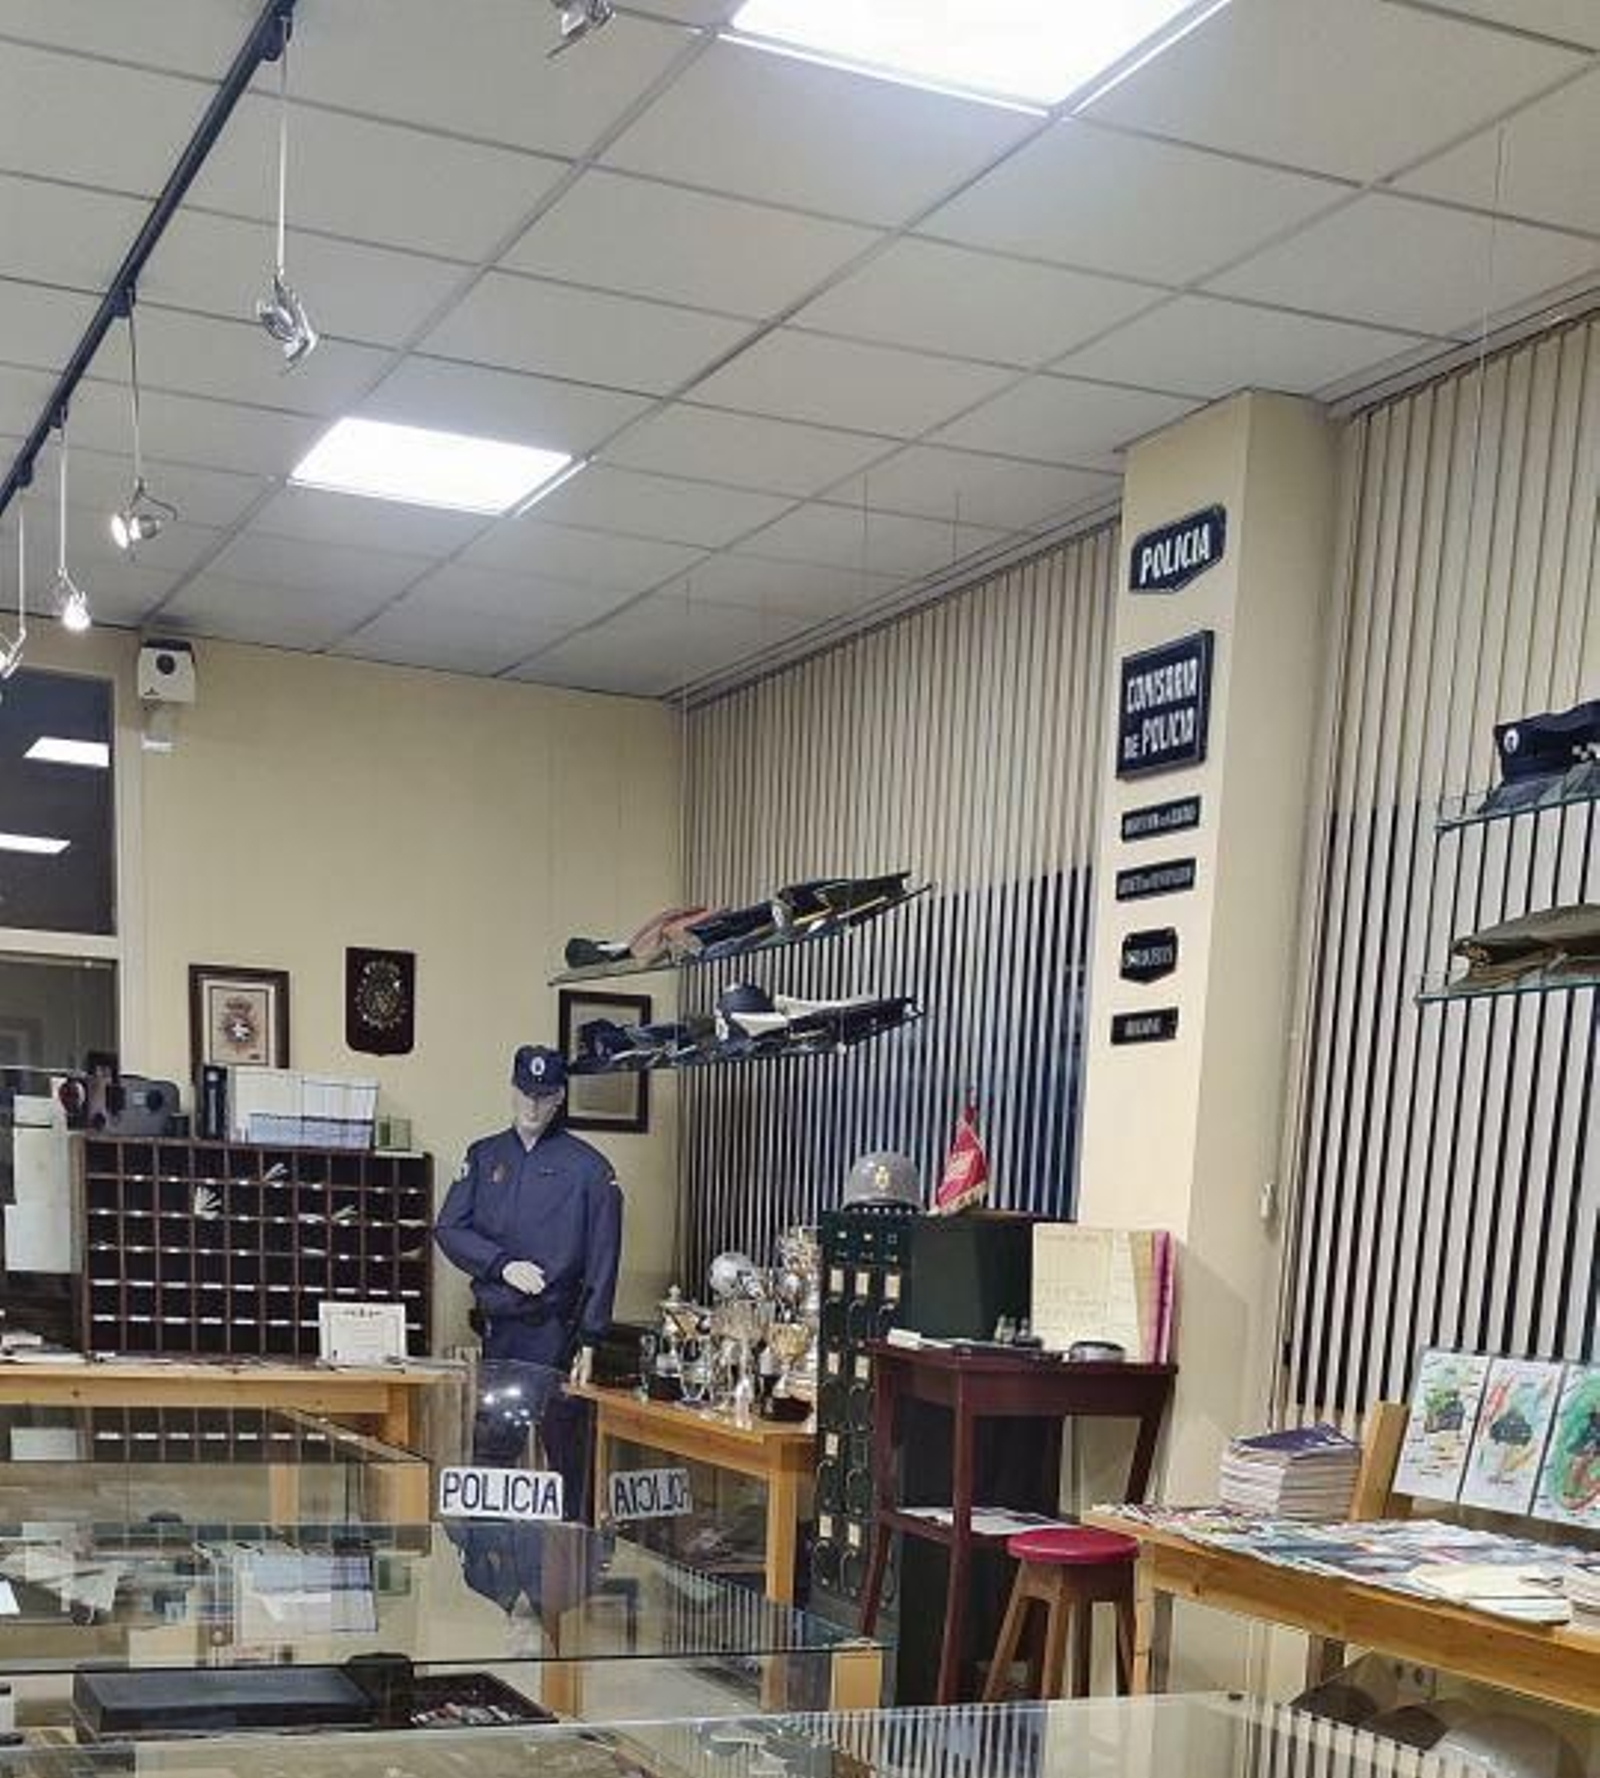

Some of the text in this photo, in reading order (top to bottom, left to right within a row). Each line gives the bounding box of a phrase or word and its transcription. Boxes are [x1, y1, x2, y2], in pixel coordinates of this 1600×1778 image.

[1138, 522, 1210, 585] POLICIA
[1141, 706, 1195, 757] POLICIA
[442, 1471, 560, 1517] POLICIA
